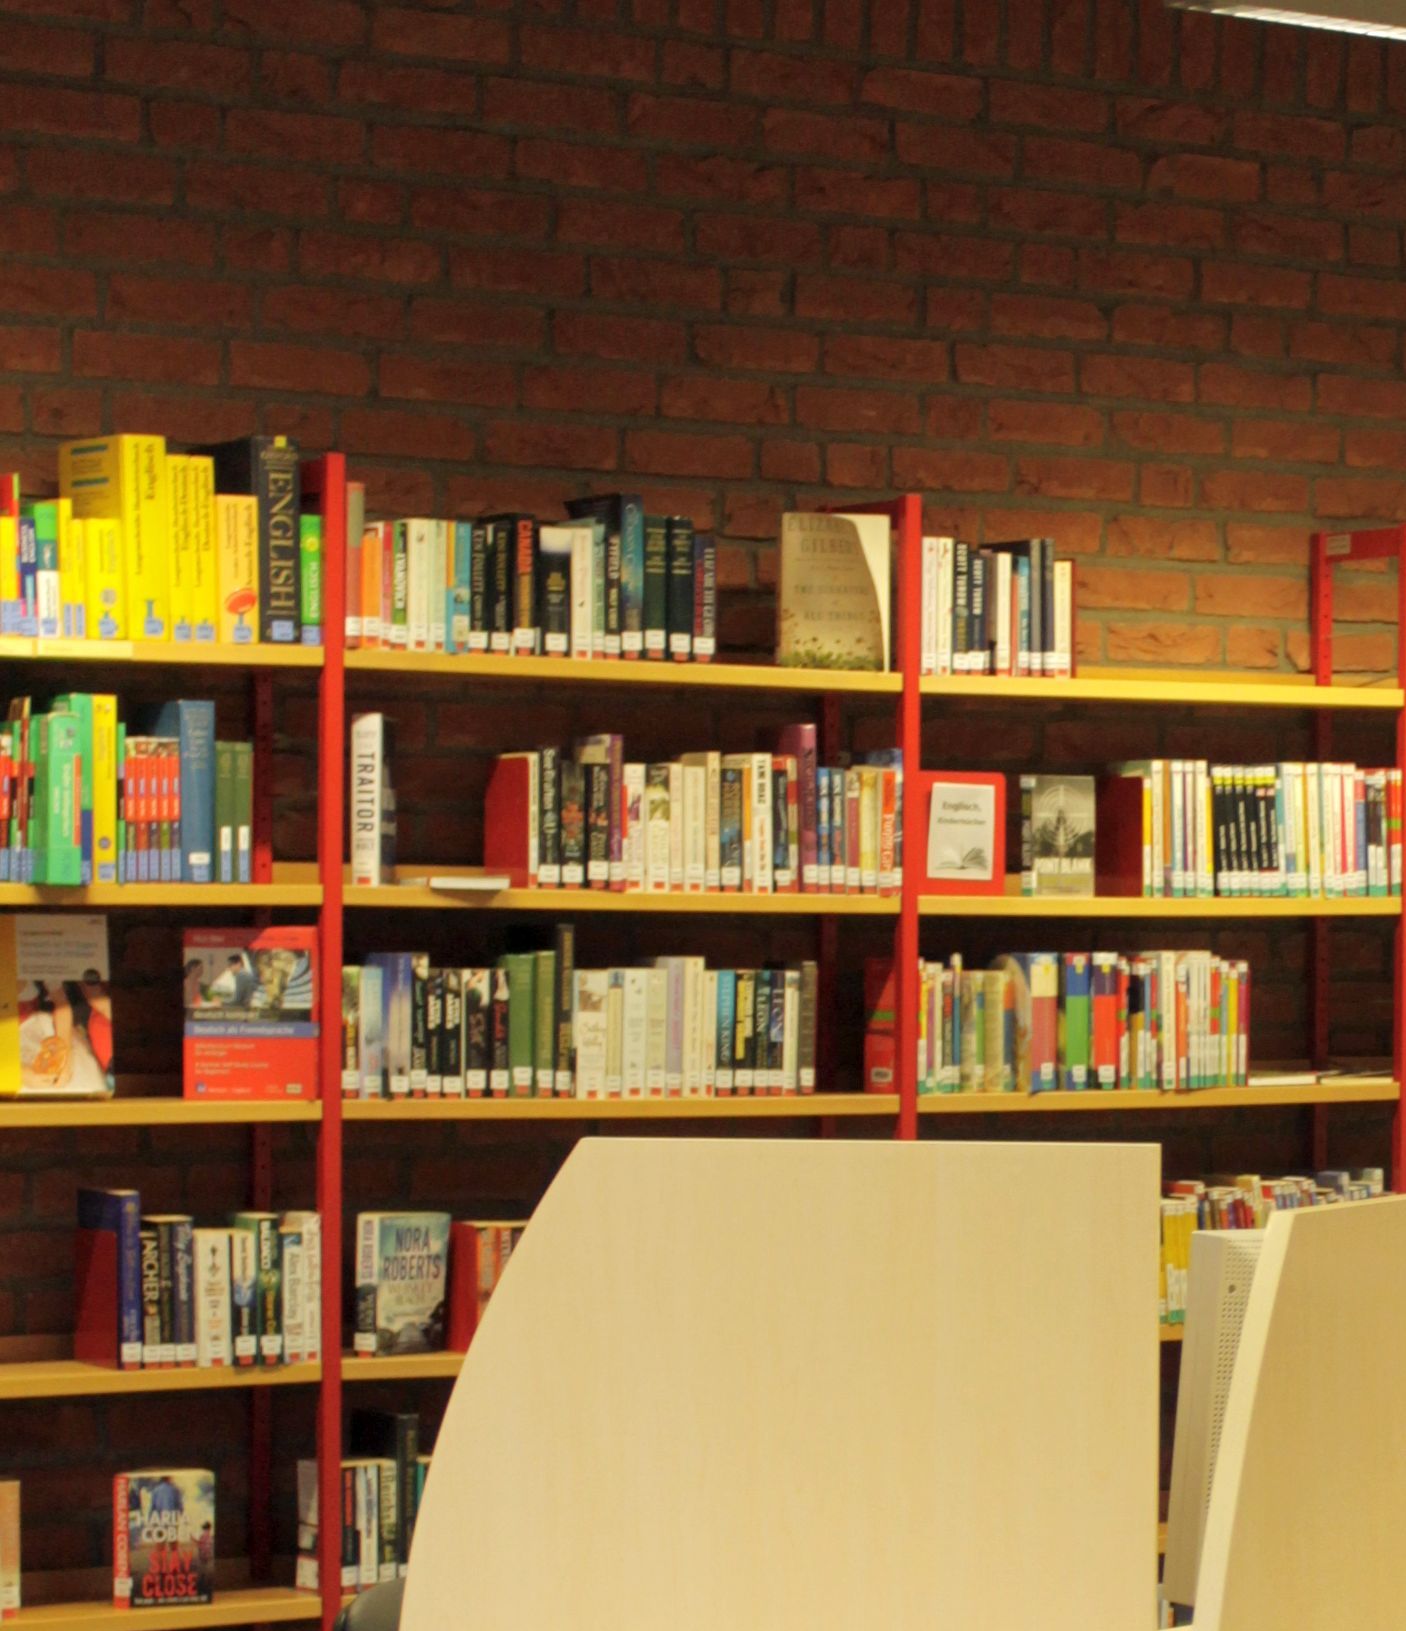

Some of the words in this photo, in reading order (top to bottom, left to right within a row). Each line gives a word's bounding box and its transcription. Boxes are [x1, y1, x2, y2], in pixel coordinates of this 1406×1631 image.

[269, 472, 297, 609] ENGLISH
[472, 529, 486, 550] KEN
[517, 519, 533, 574] CANADA
[472, 552, 487, 593] FOLLETT
[957, 543, 968, 573] SCOTT
[356, 751, 376, 832] TRAITOR
[720, 975, 732, 1028] STEPHEN
[720, 1029, 731, 1061] KING
[397, 1226, 433, 1253] NORA
[143, 1240, 159, 1302] ARCHER
[382, 1253, 442, 1281] ROBERTS
[148, 1551, 193, 1573] STAY
[142, 1573, 198, 1598] CLOSE
